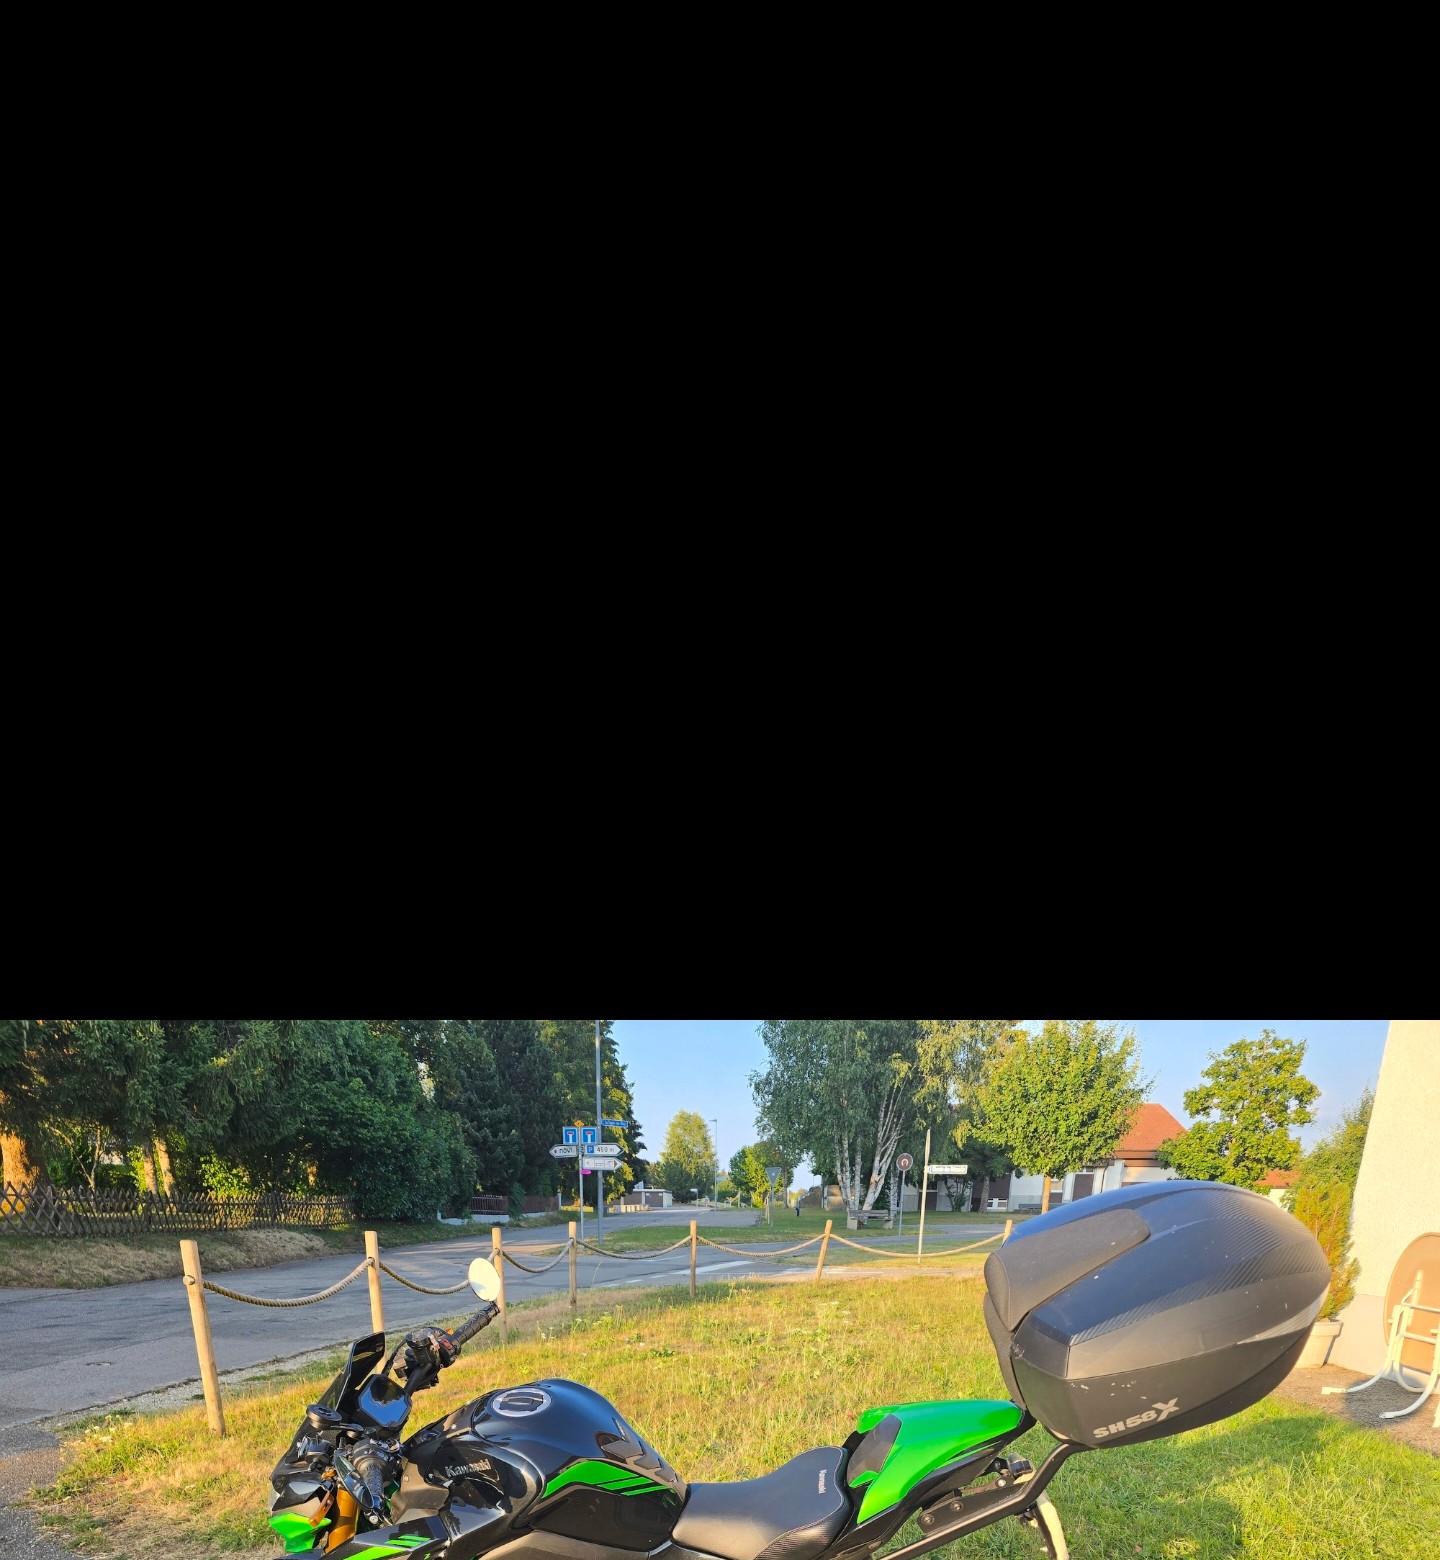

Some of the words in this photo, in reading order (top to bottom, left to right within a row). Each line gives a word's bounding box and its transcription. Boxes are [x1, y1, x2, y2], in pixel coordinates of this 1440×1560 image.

[1093, 1397, 1180, 1438] SH58X
[444, 1458, 492, 1477] Kawasaki
[818, 1469, 827, 1494] Kawasaki
